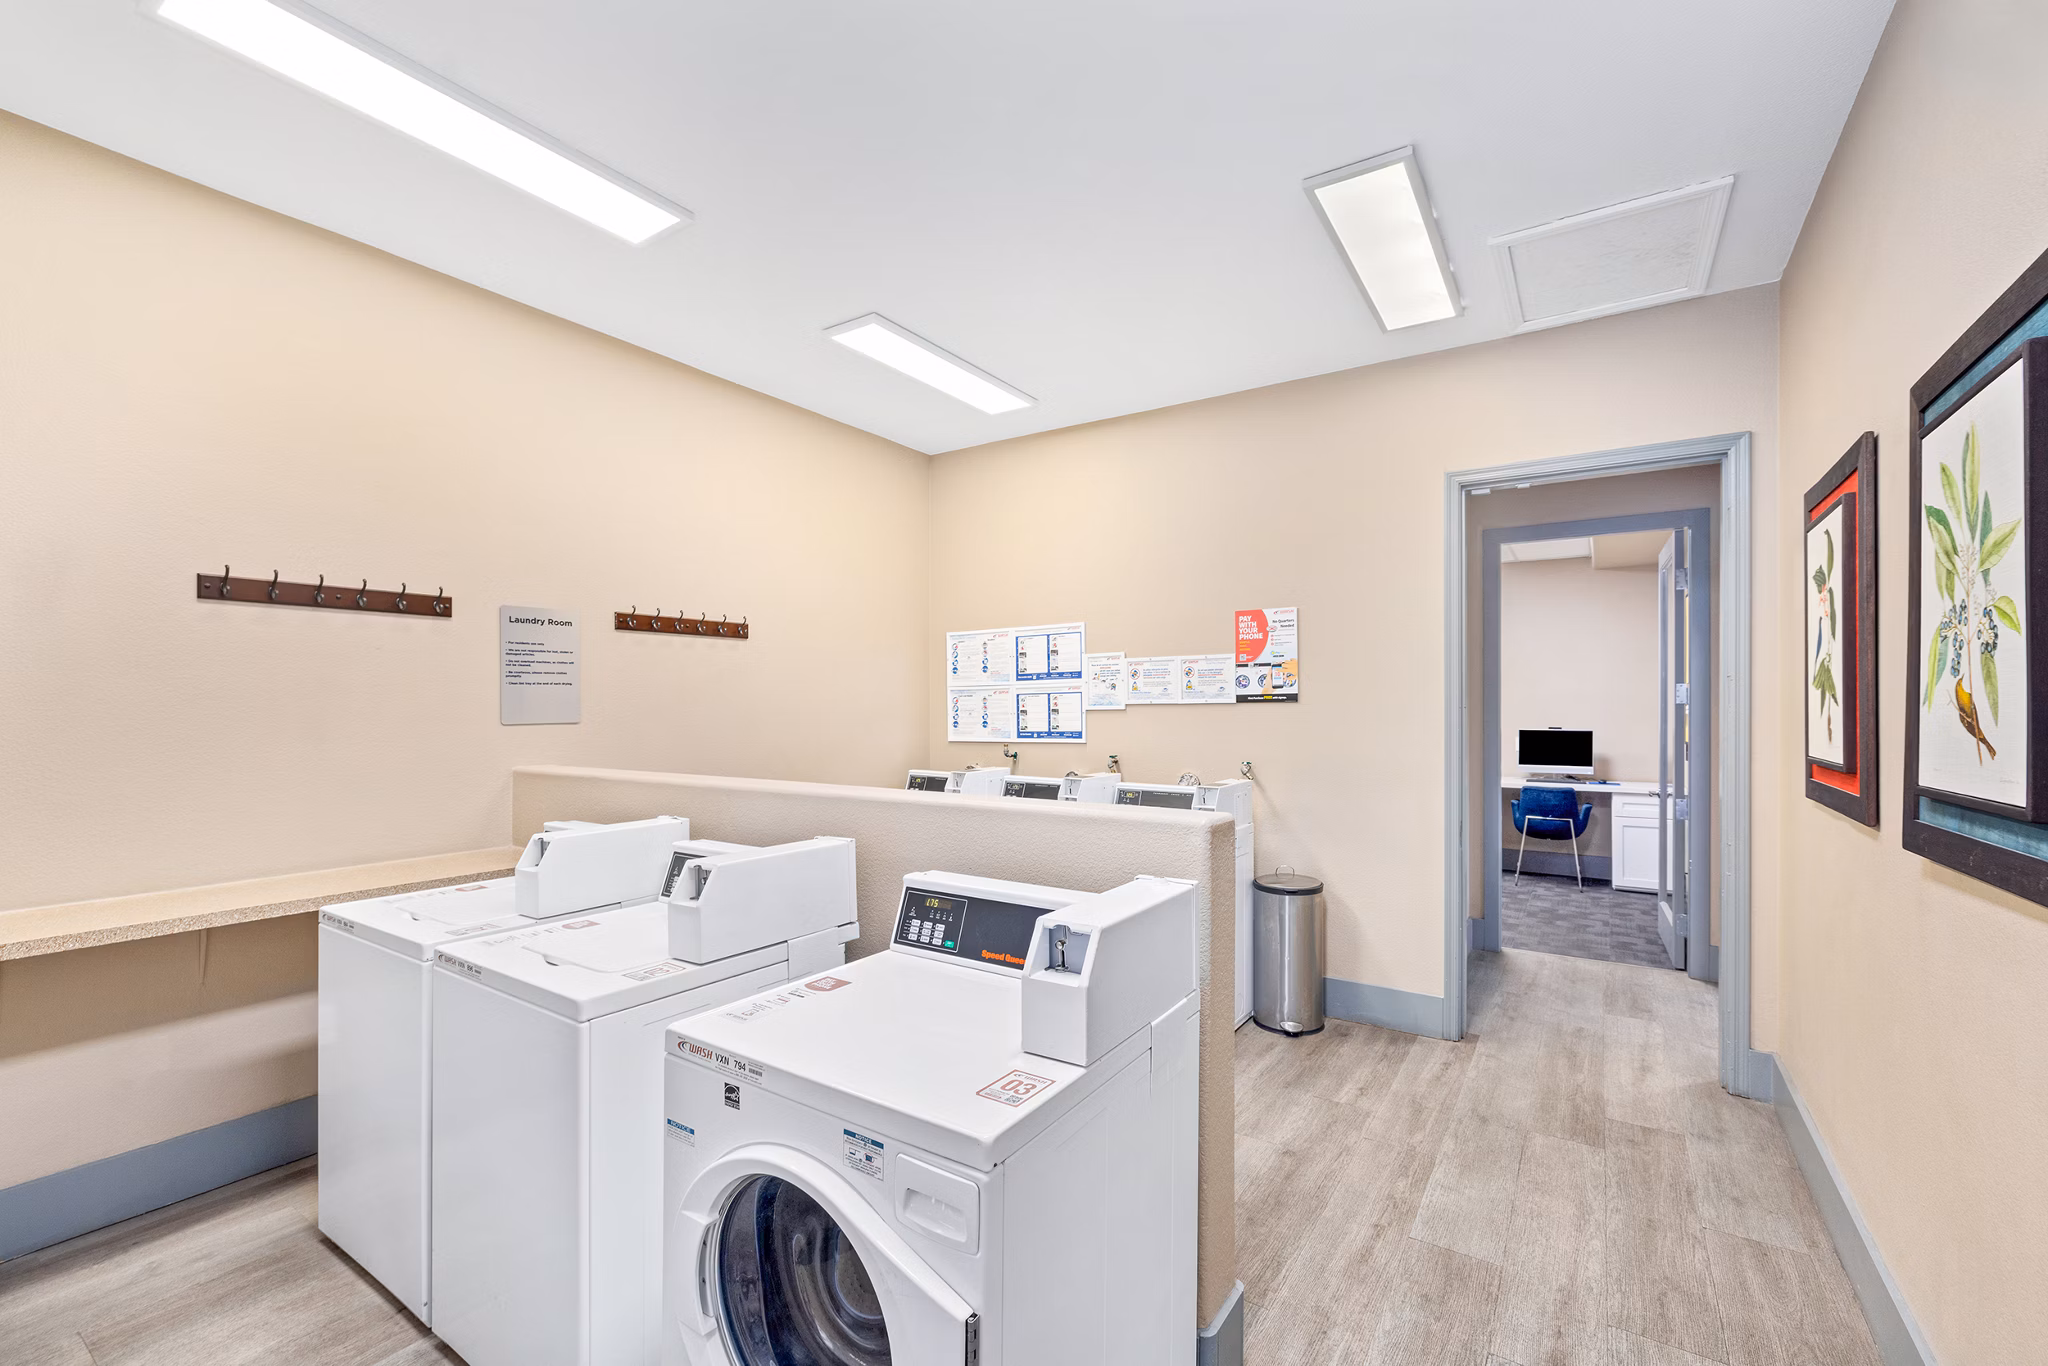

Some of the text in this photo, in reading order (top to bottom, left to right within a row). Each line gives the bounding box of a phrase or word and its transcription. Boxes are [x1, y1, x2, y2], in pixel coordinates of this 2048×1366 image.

[509, 616, 545, 626] Laundry
[982, 950, 1005, 961] Speed
[689, 1042, 746, 1072] WASH VXN 794
[1000, 1079, 1037, 1095] 03
[670, 1120, 690, 1133] NOTICE
[856, 1134, 872, 1144] NOTICE
